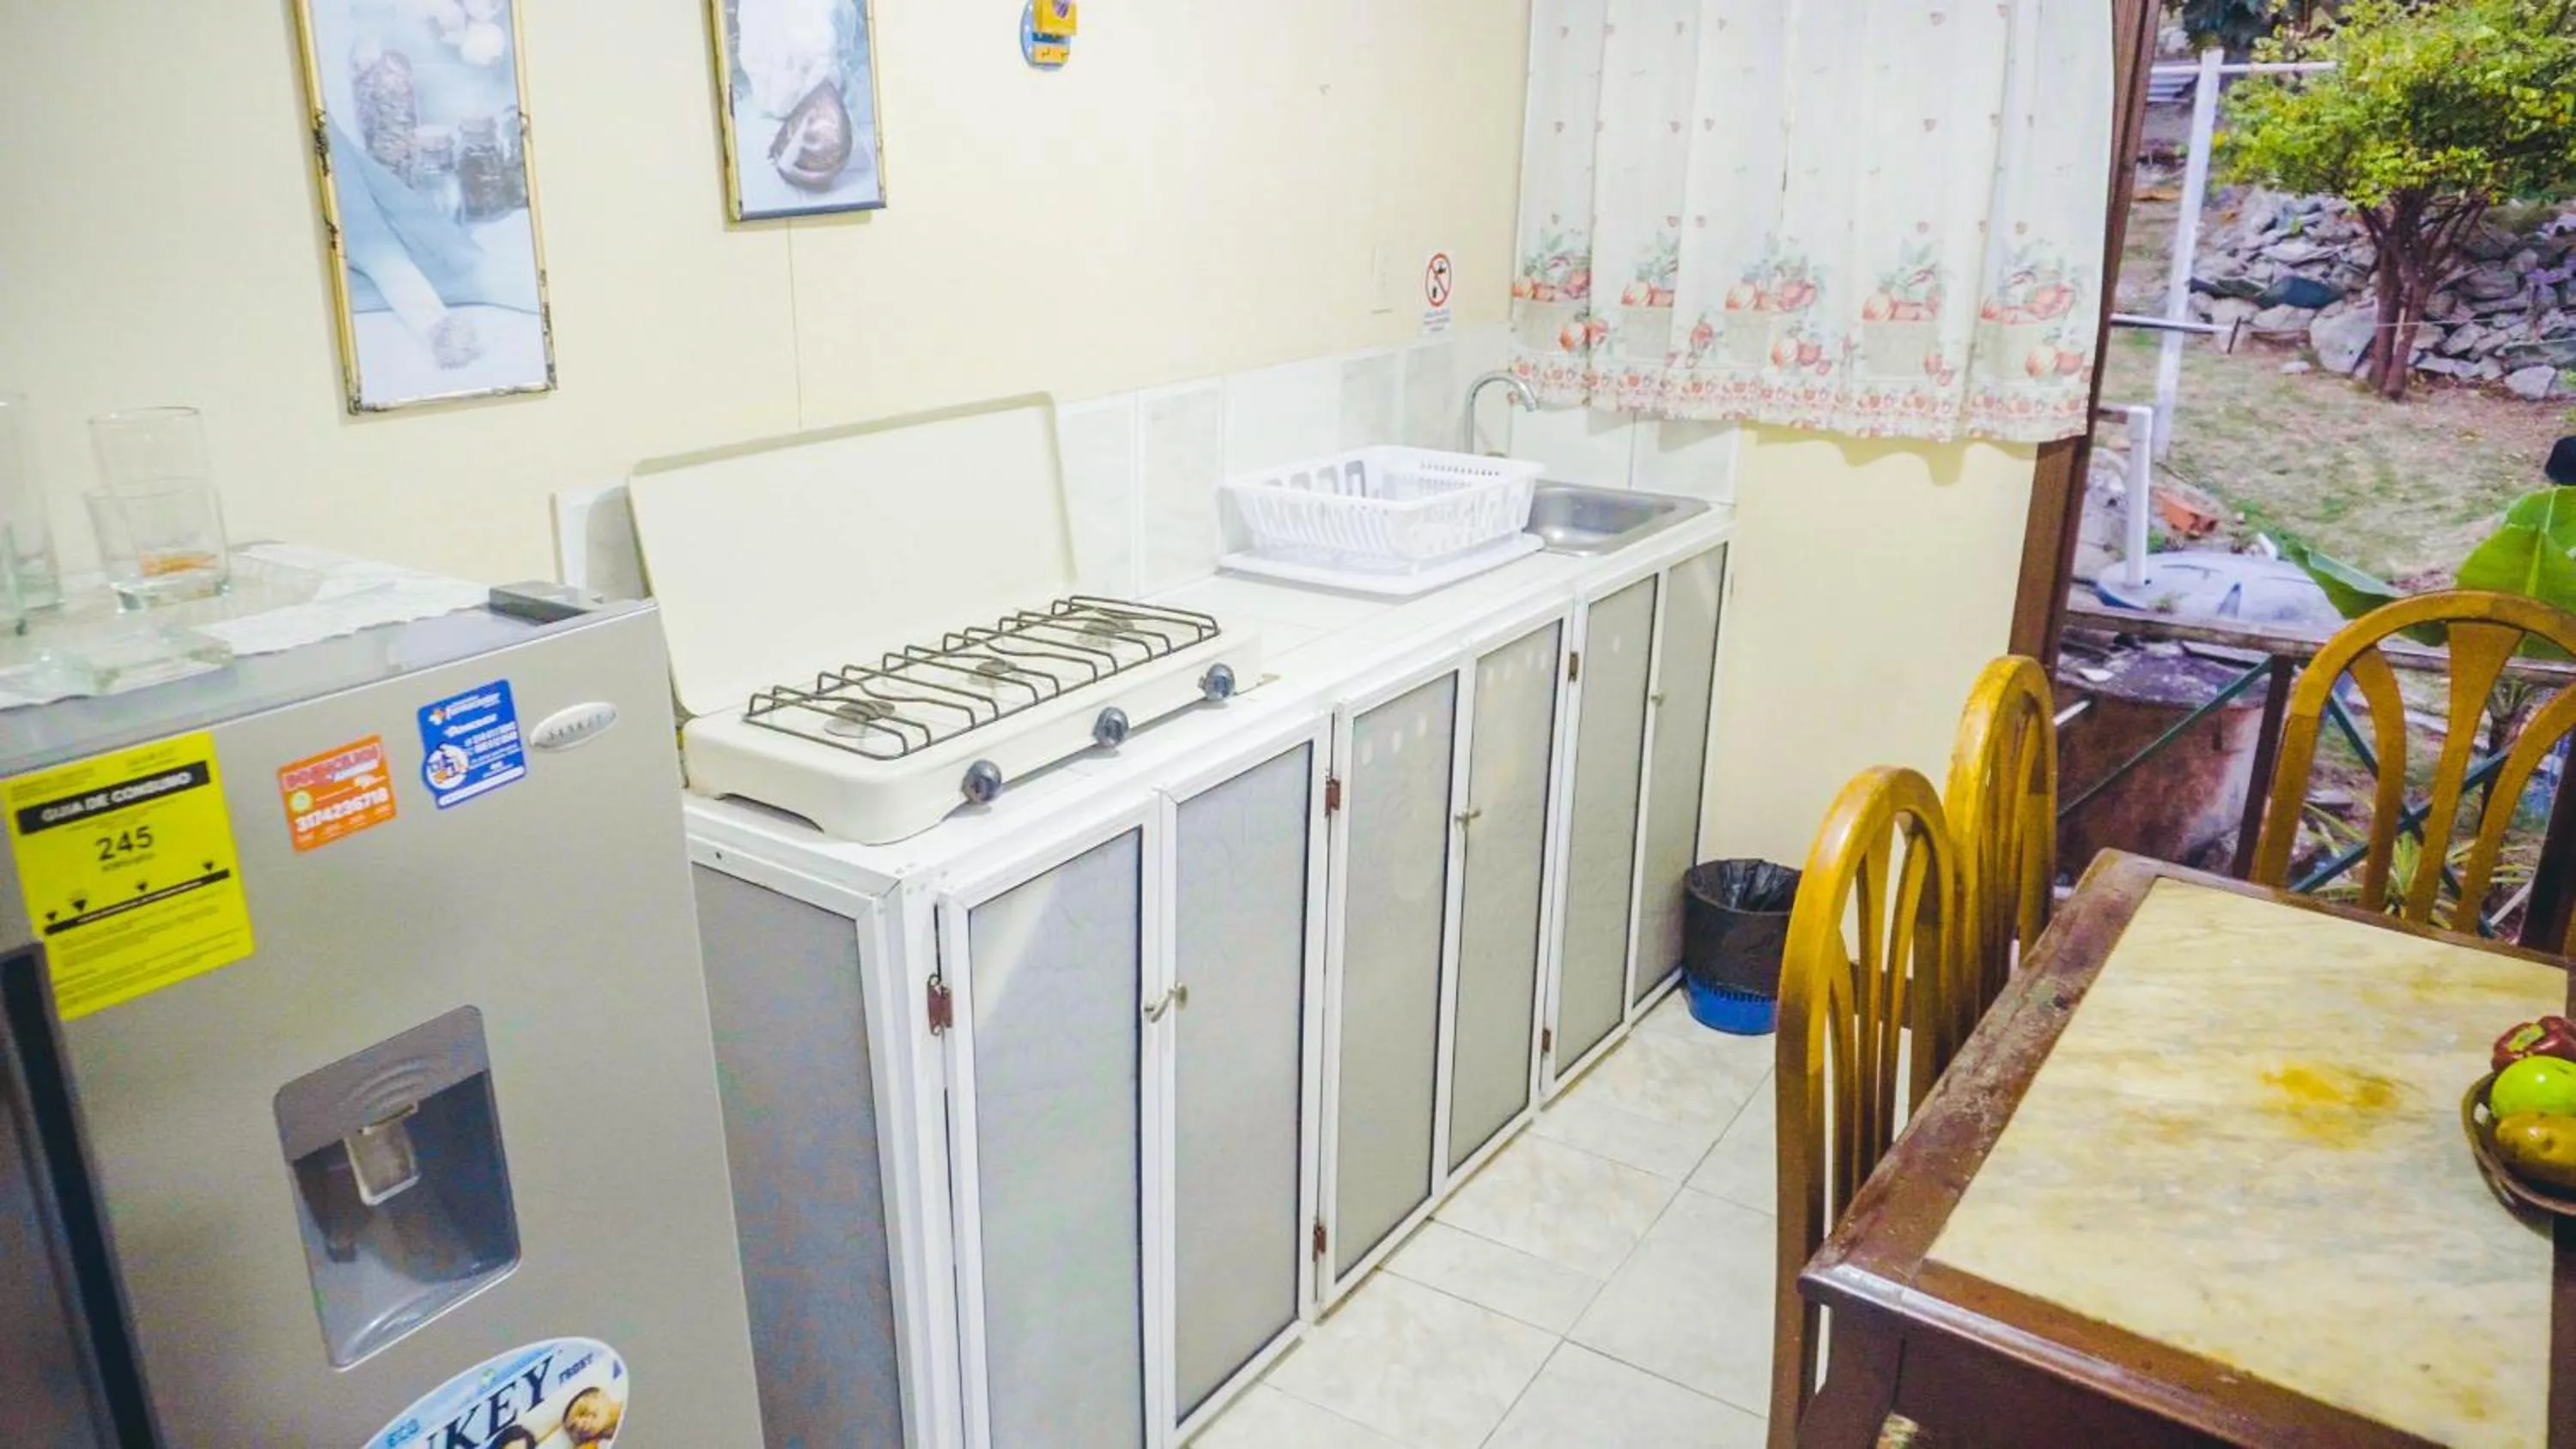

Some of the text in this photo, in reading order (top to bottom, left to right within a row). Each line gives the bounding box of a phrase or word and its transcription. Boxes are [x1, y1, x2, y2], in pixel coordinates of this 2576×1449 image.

[85, 792, 110, 810] DE
[95, 826, 154, 861] 245
[427, 1355, 555, 1449] KEY
